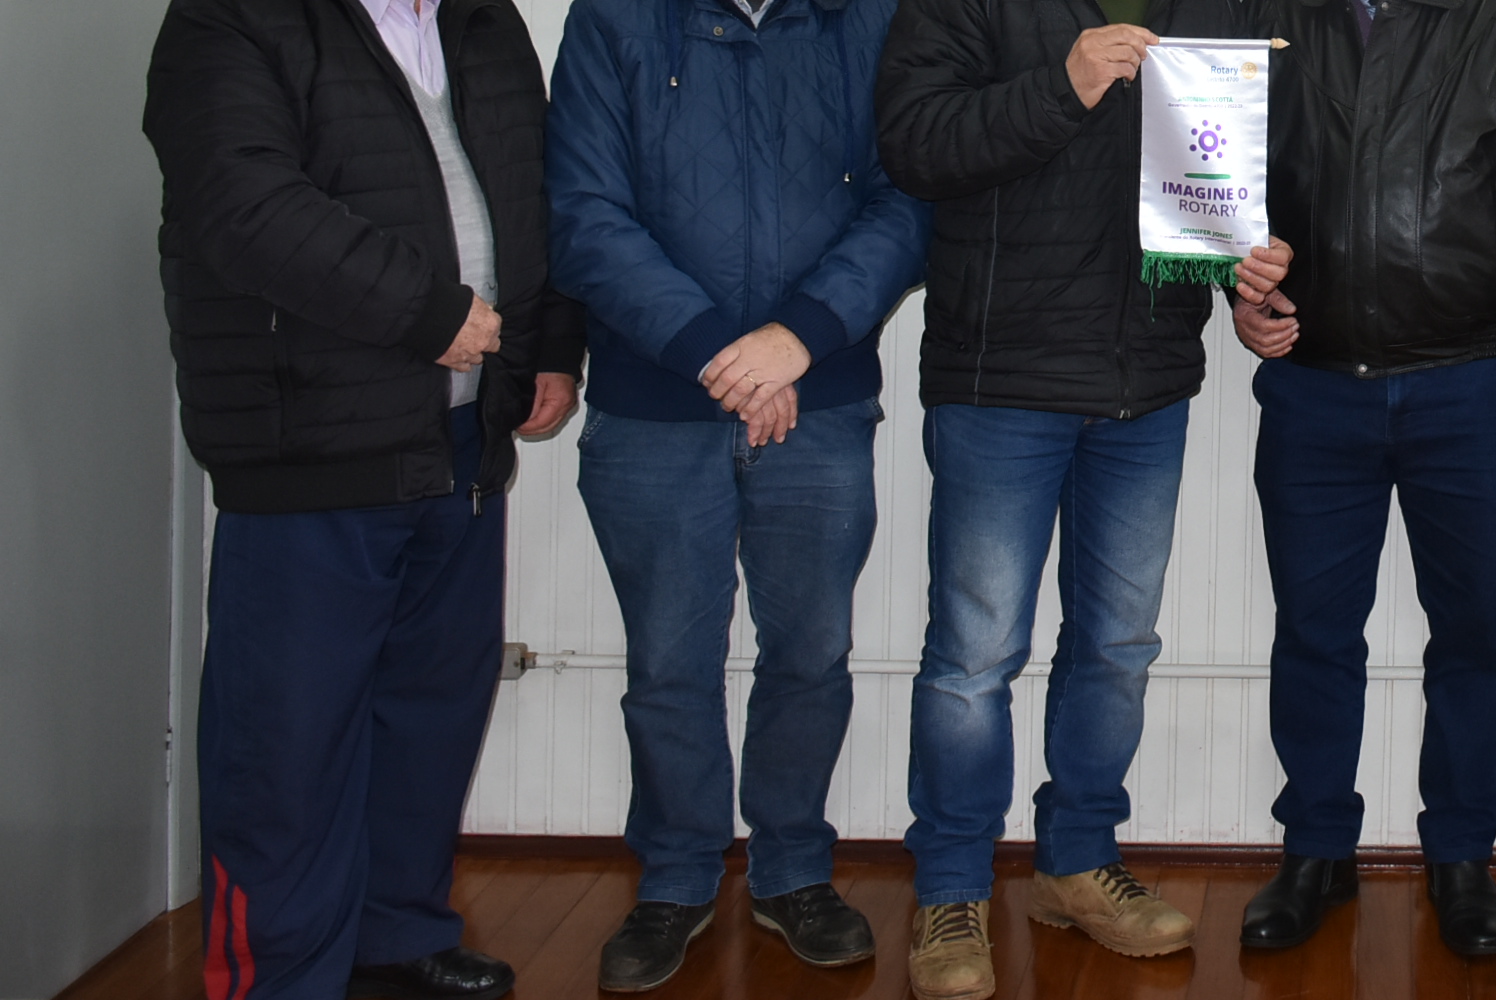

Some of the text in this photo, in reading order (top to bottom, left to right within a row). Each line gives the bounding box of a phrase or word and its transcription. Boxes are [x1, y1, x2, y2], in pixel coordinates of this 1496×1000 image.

[1210, 65, 1239, 76] Rotary
[1162, 181, 1248, 201] IMAGINE O
[1178, 199, 1238, 217] ROTARY
[1180, 228, 1233, 240] JENNIFER JONES
